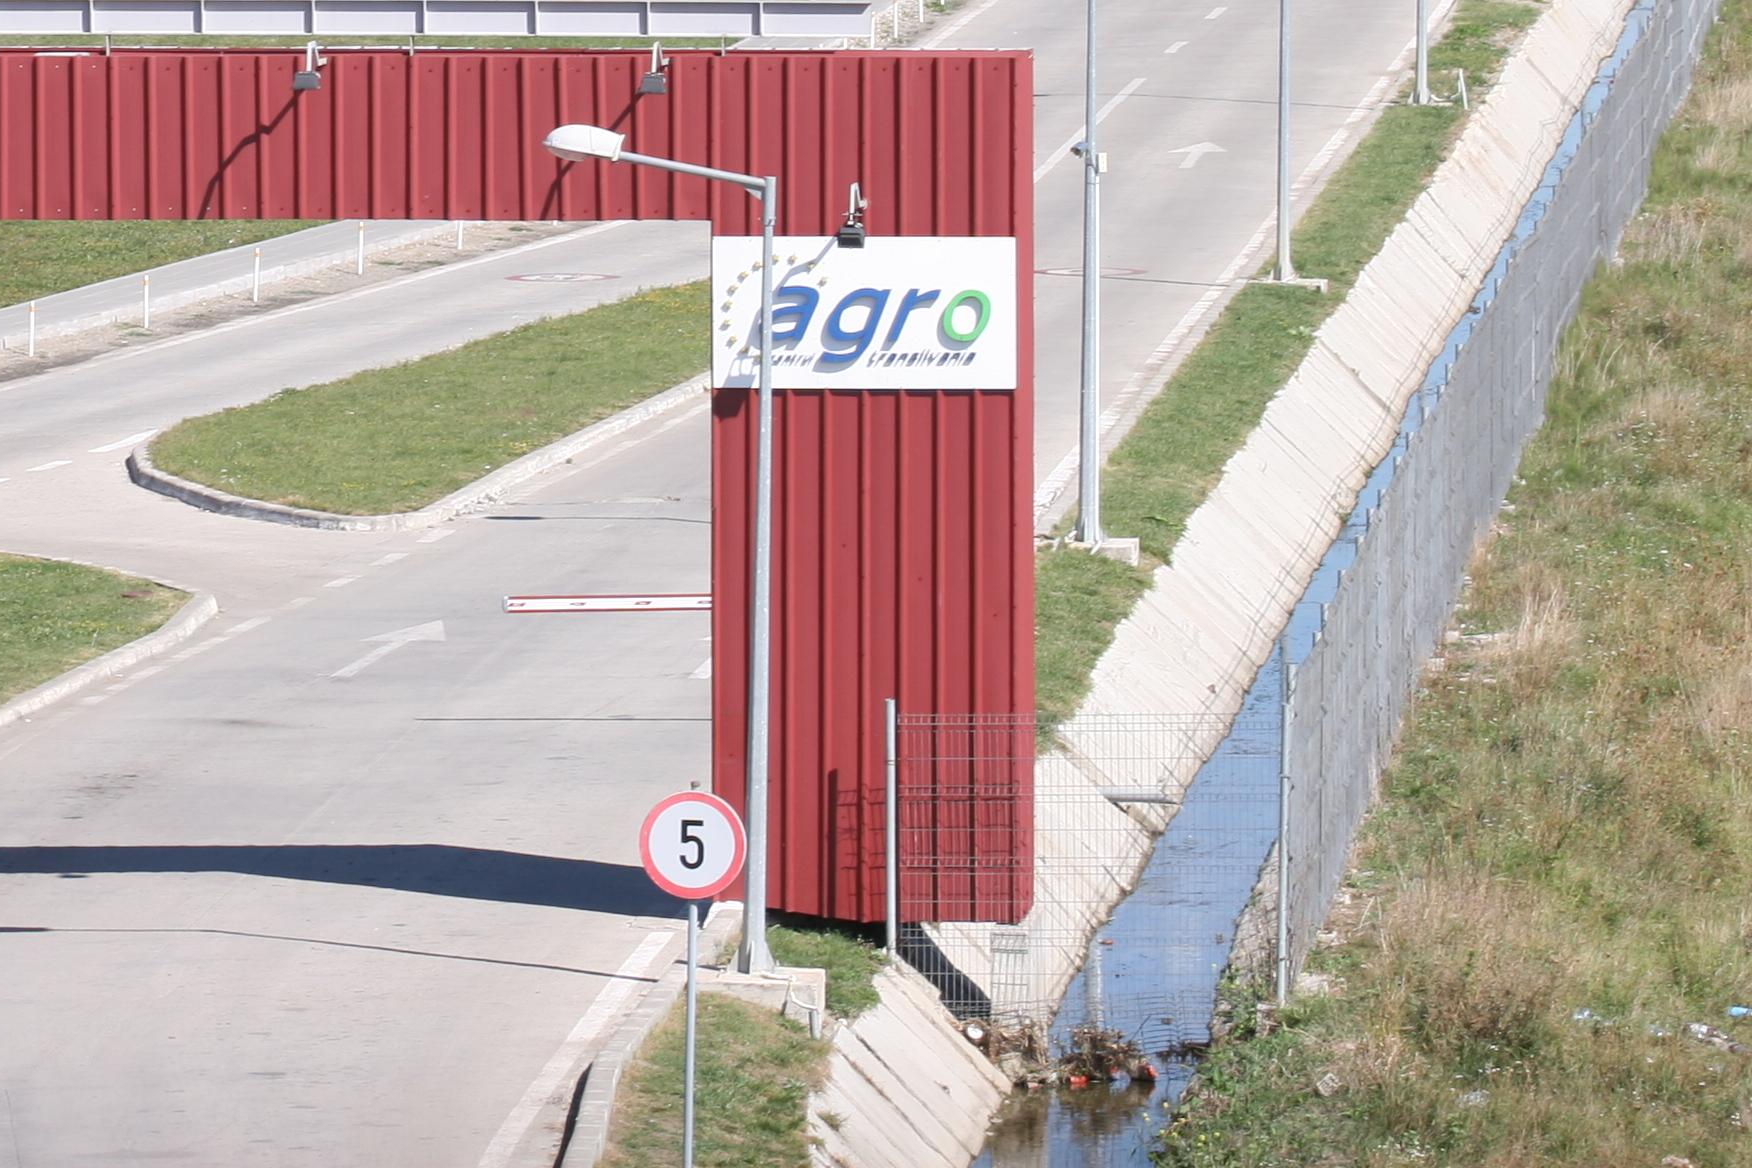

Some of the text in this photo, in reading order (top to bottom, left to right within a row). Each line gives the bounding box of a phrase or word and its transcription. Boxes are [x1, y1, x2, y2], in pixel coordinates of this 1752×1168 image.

[759, 285, 991, 363] agro
[866, 348, 977, 368] transilvania
[679, 819, 705, 870] 5
